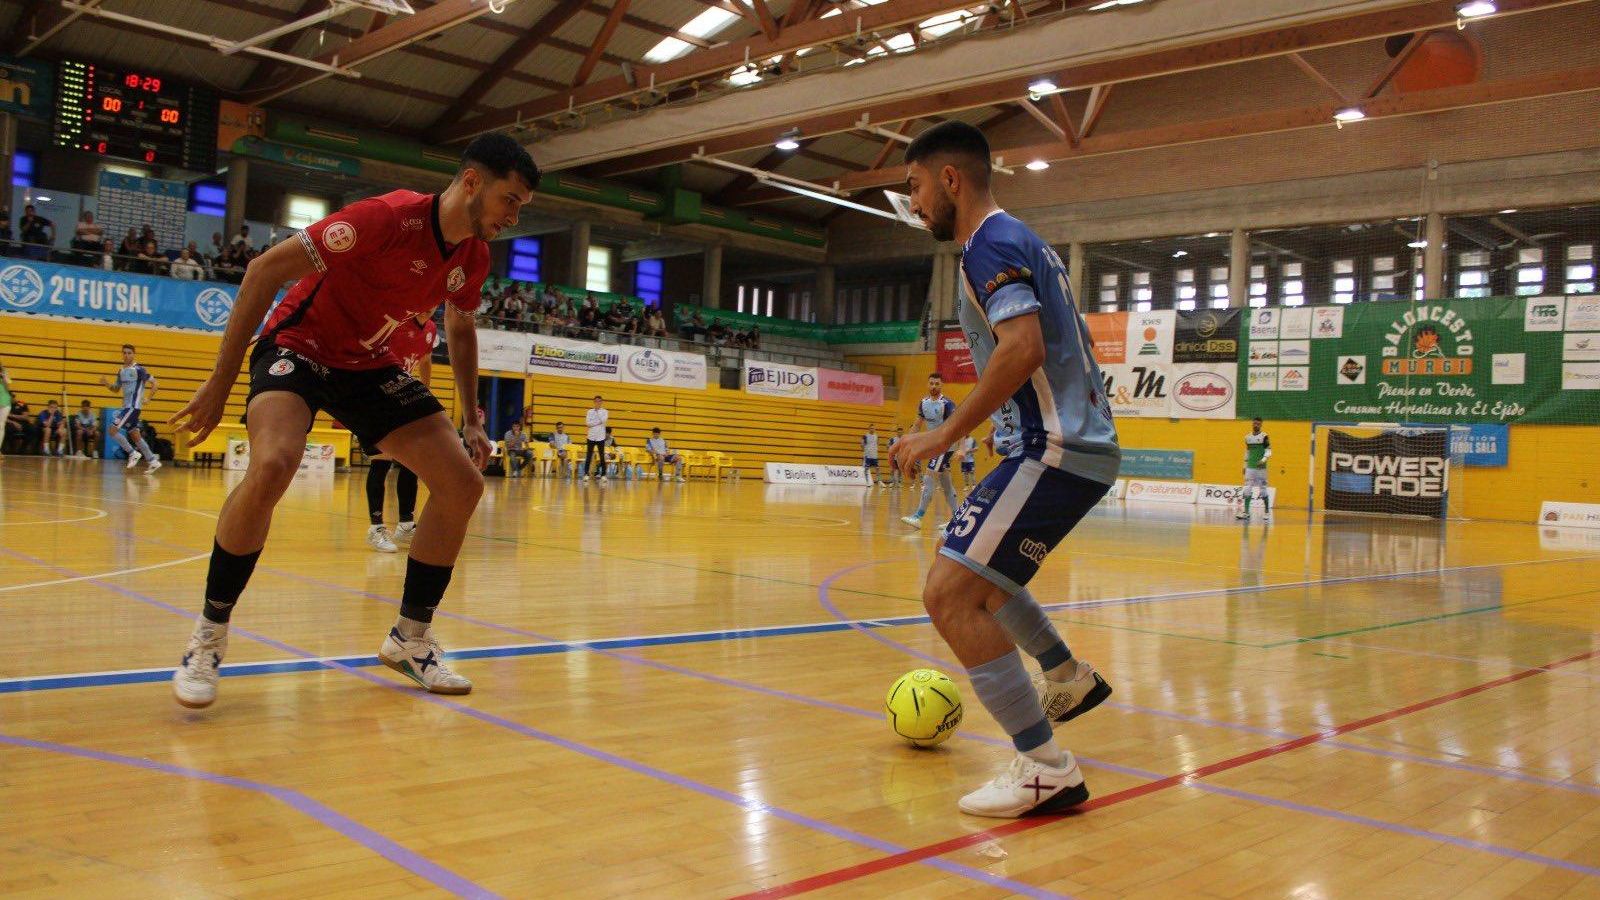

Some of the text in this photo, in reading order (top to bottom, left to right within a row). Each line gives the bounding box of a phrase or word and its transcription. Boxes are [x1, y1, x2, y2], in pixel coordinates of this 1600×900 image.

[124, 73, 162, 93] 18:29
[102, 96, 122, 113] 00
[160, 108, 179, 124] 00
[78, 278, 153, 315] FUTSAL
[1382, 305, 1474, 357] BALONCESTO
[1389, 360, 1466, 373] MURGI
[767, 371, 815, 388] EJIDO
[1376, 382, 1416, 400] Piensa
[1418, 387, 1432, 397] en
[1334, 401, 1526, 420] Consume Hortalizas de El Ejido
[1330, 452, 1445, 477] POWER
[784, 469, 816, 480] Bioline
[1374, 475, 1444, 497] ADE
